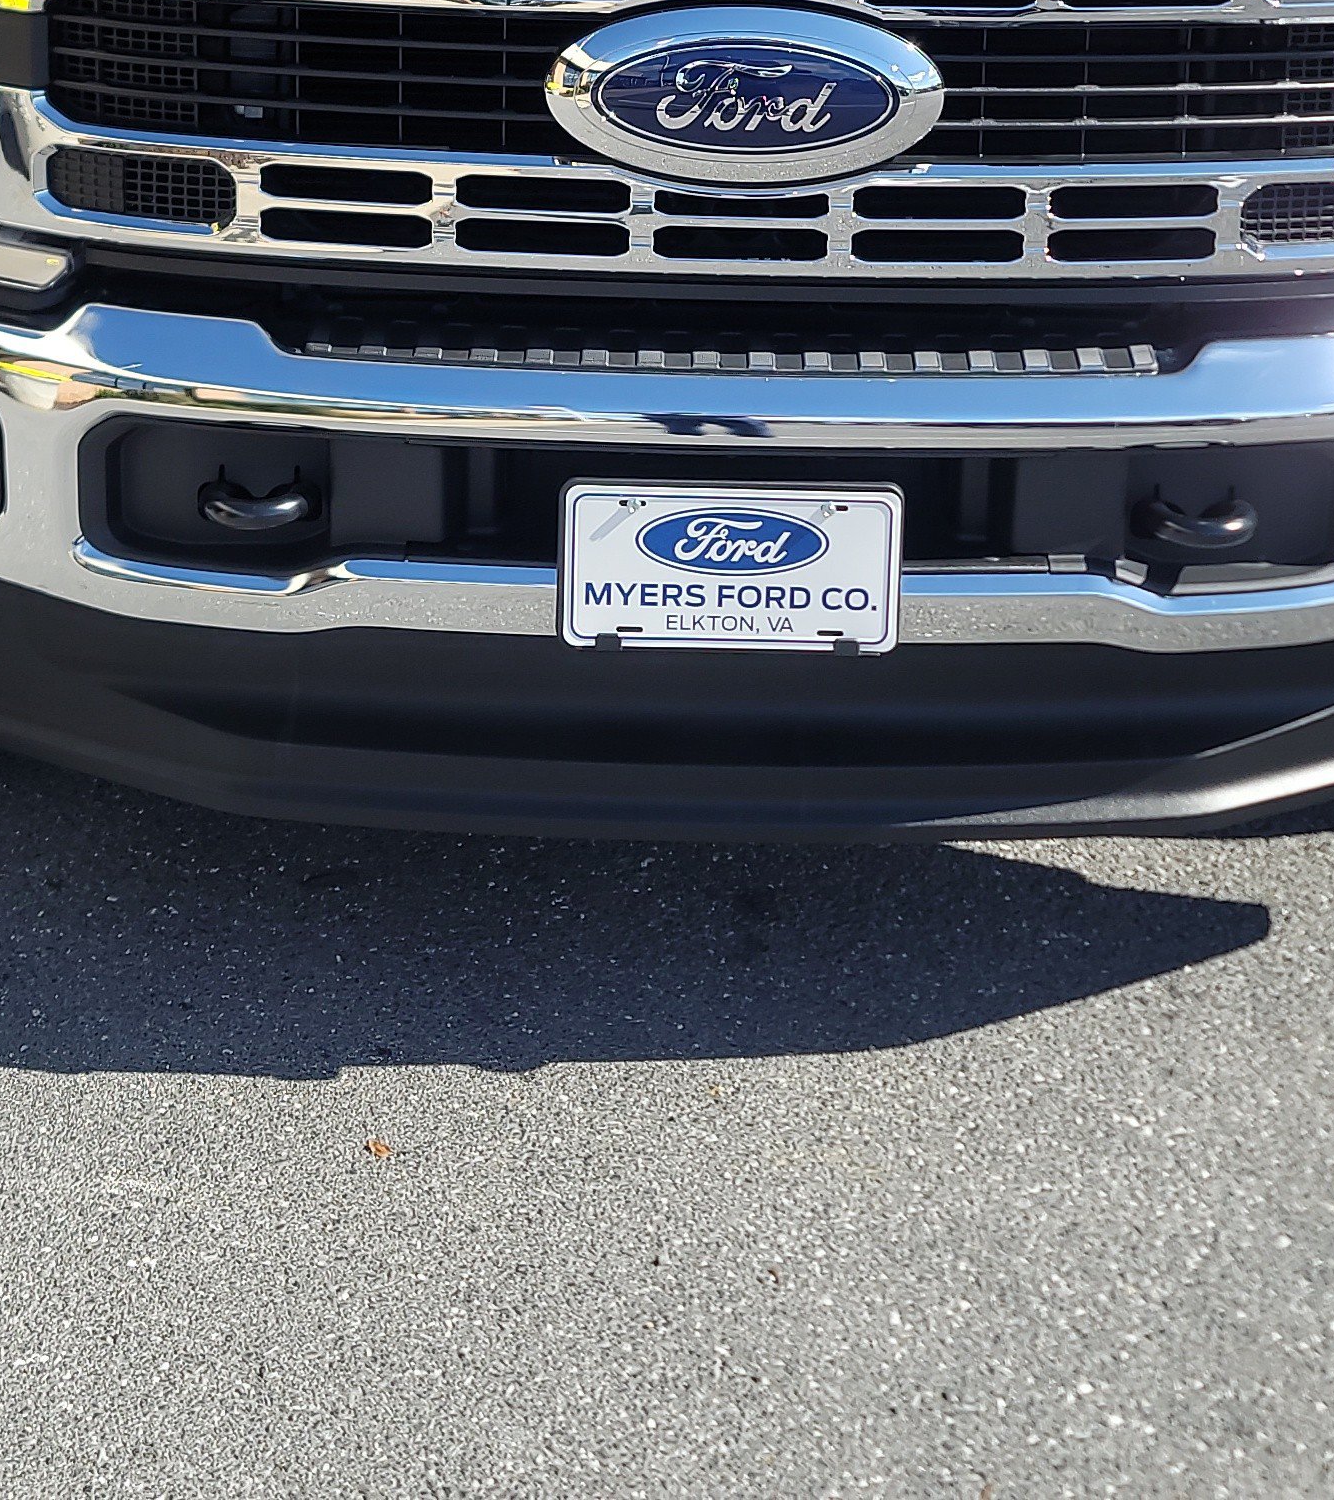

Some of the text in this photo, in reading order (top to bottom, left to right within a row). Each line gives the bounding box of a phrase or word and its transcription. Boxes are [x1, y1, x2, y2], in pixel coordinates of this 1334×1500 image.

[656, 59, 836, 133] Ford
[674, 517, 793, 563] Ford
[584, 582, 878, 612] MYERS FORD CO.
[666, 614, 794, 634] ELKTON, VA
